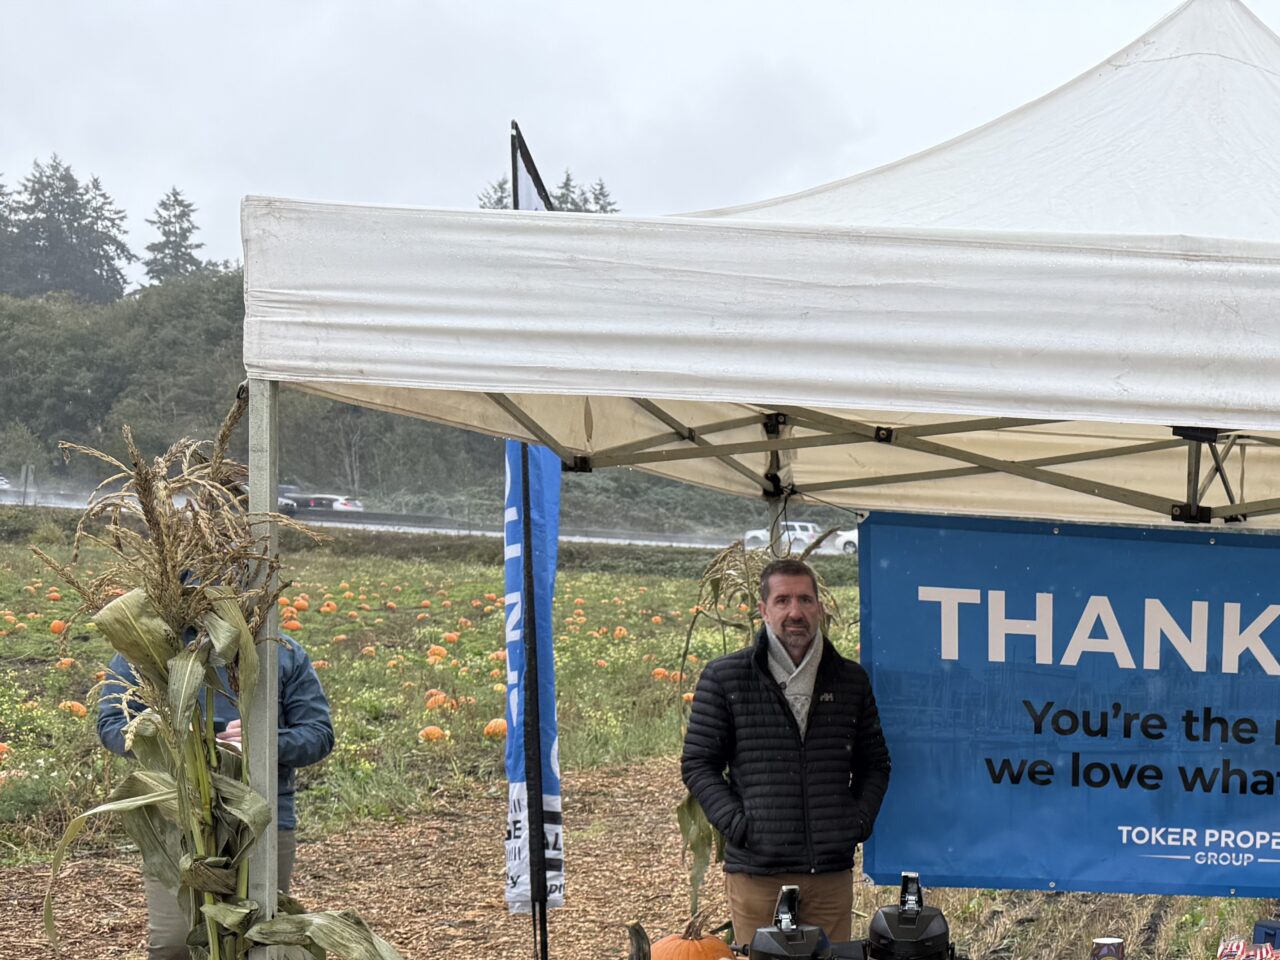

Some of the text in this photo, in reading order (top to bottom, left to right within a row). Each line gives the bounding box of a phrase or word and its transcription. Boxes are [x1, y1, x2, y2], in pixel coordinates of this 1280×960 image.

[1022, 699, 1168, 740] You're
[1182, 706, 1258, 745] the
[984, 756, 1053, 786] we
[1071, 752, 1163, 791] love
[1117, 825, 1197, 848] TOKER
[1194, 851, 1254, 867] GROUP
